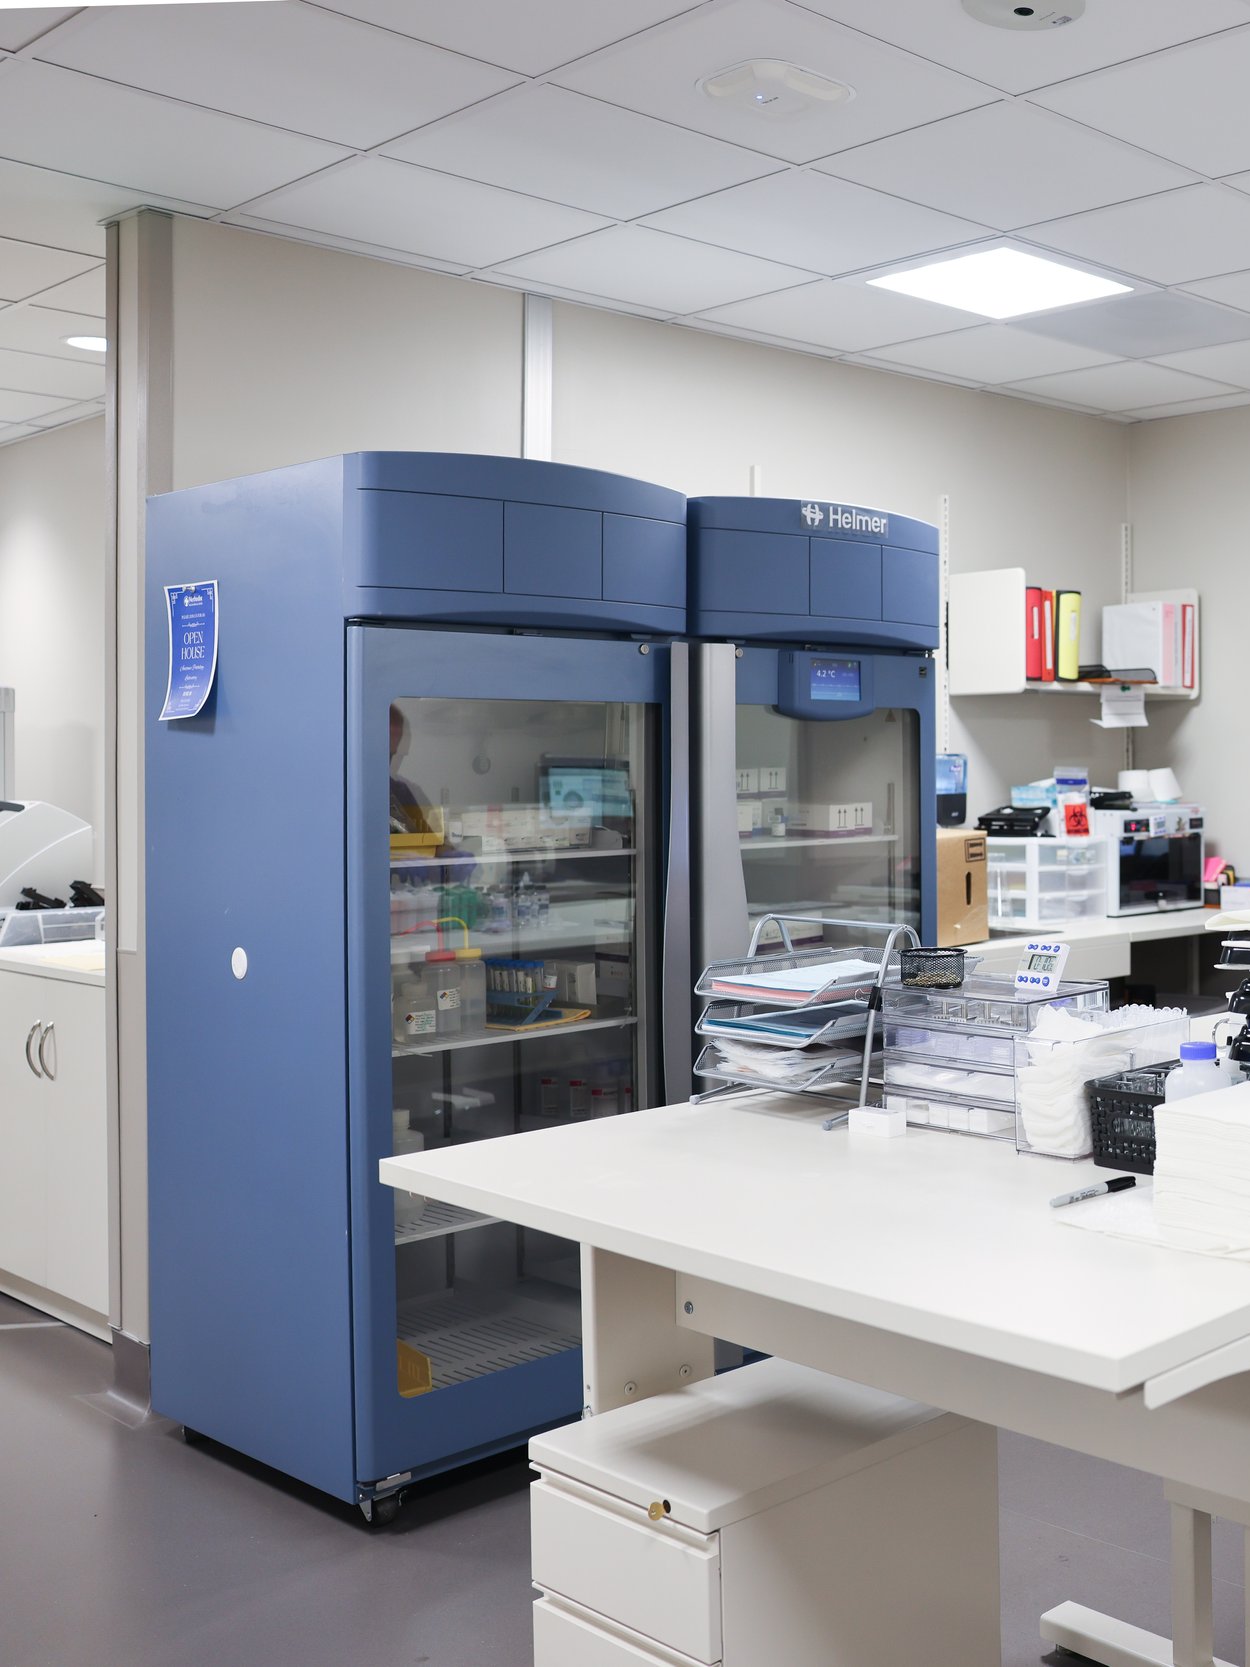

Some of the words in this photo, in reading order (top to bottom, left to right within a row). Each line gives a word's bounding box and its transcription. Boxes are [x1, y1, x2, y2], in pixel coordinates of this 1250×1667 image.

[829, 505, 887, 534] Helmer
[183, 631, 204, 645] OPEN
[181, 645, 205, 660] HOUSE
[816, 669, 826, 678] 4.2
